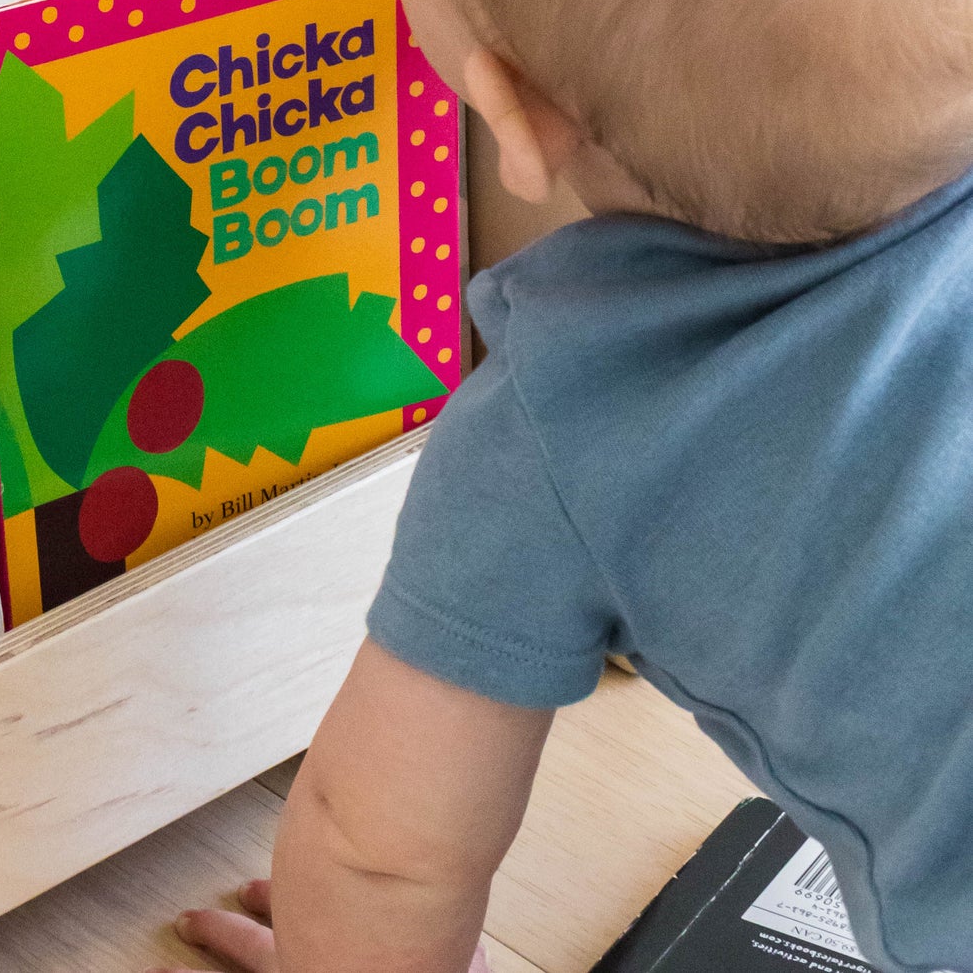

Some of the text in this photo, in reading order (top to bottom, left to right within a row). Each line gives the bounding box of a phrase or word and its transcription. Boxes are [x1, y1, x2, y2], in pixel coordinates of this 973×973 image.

[169, 18, 375, 108] Chicka
[174, 73, 375, 164] Chicka
[209, 131, 380, 212] Boom
[212, 182, 380, 266] Boom
[191, 510, 215, 530] by
[220, 490, 254, 520] Bill
[791, 925, 823, 941] CAN
